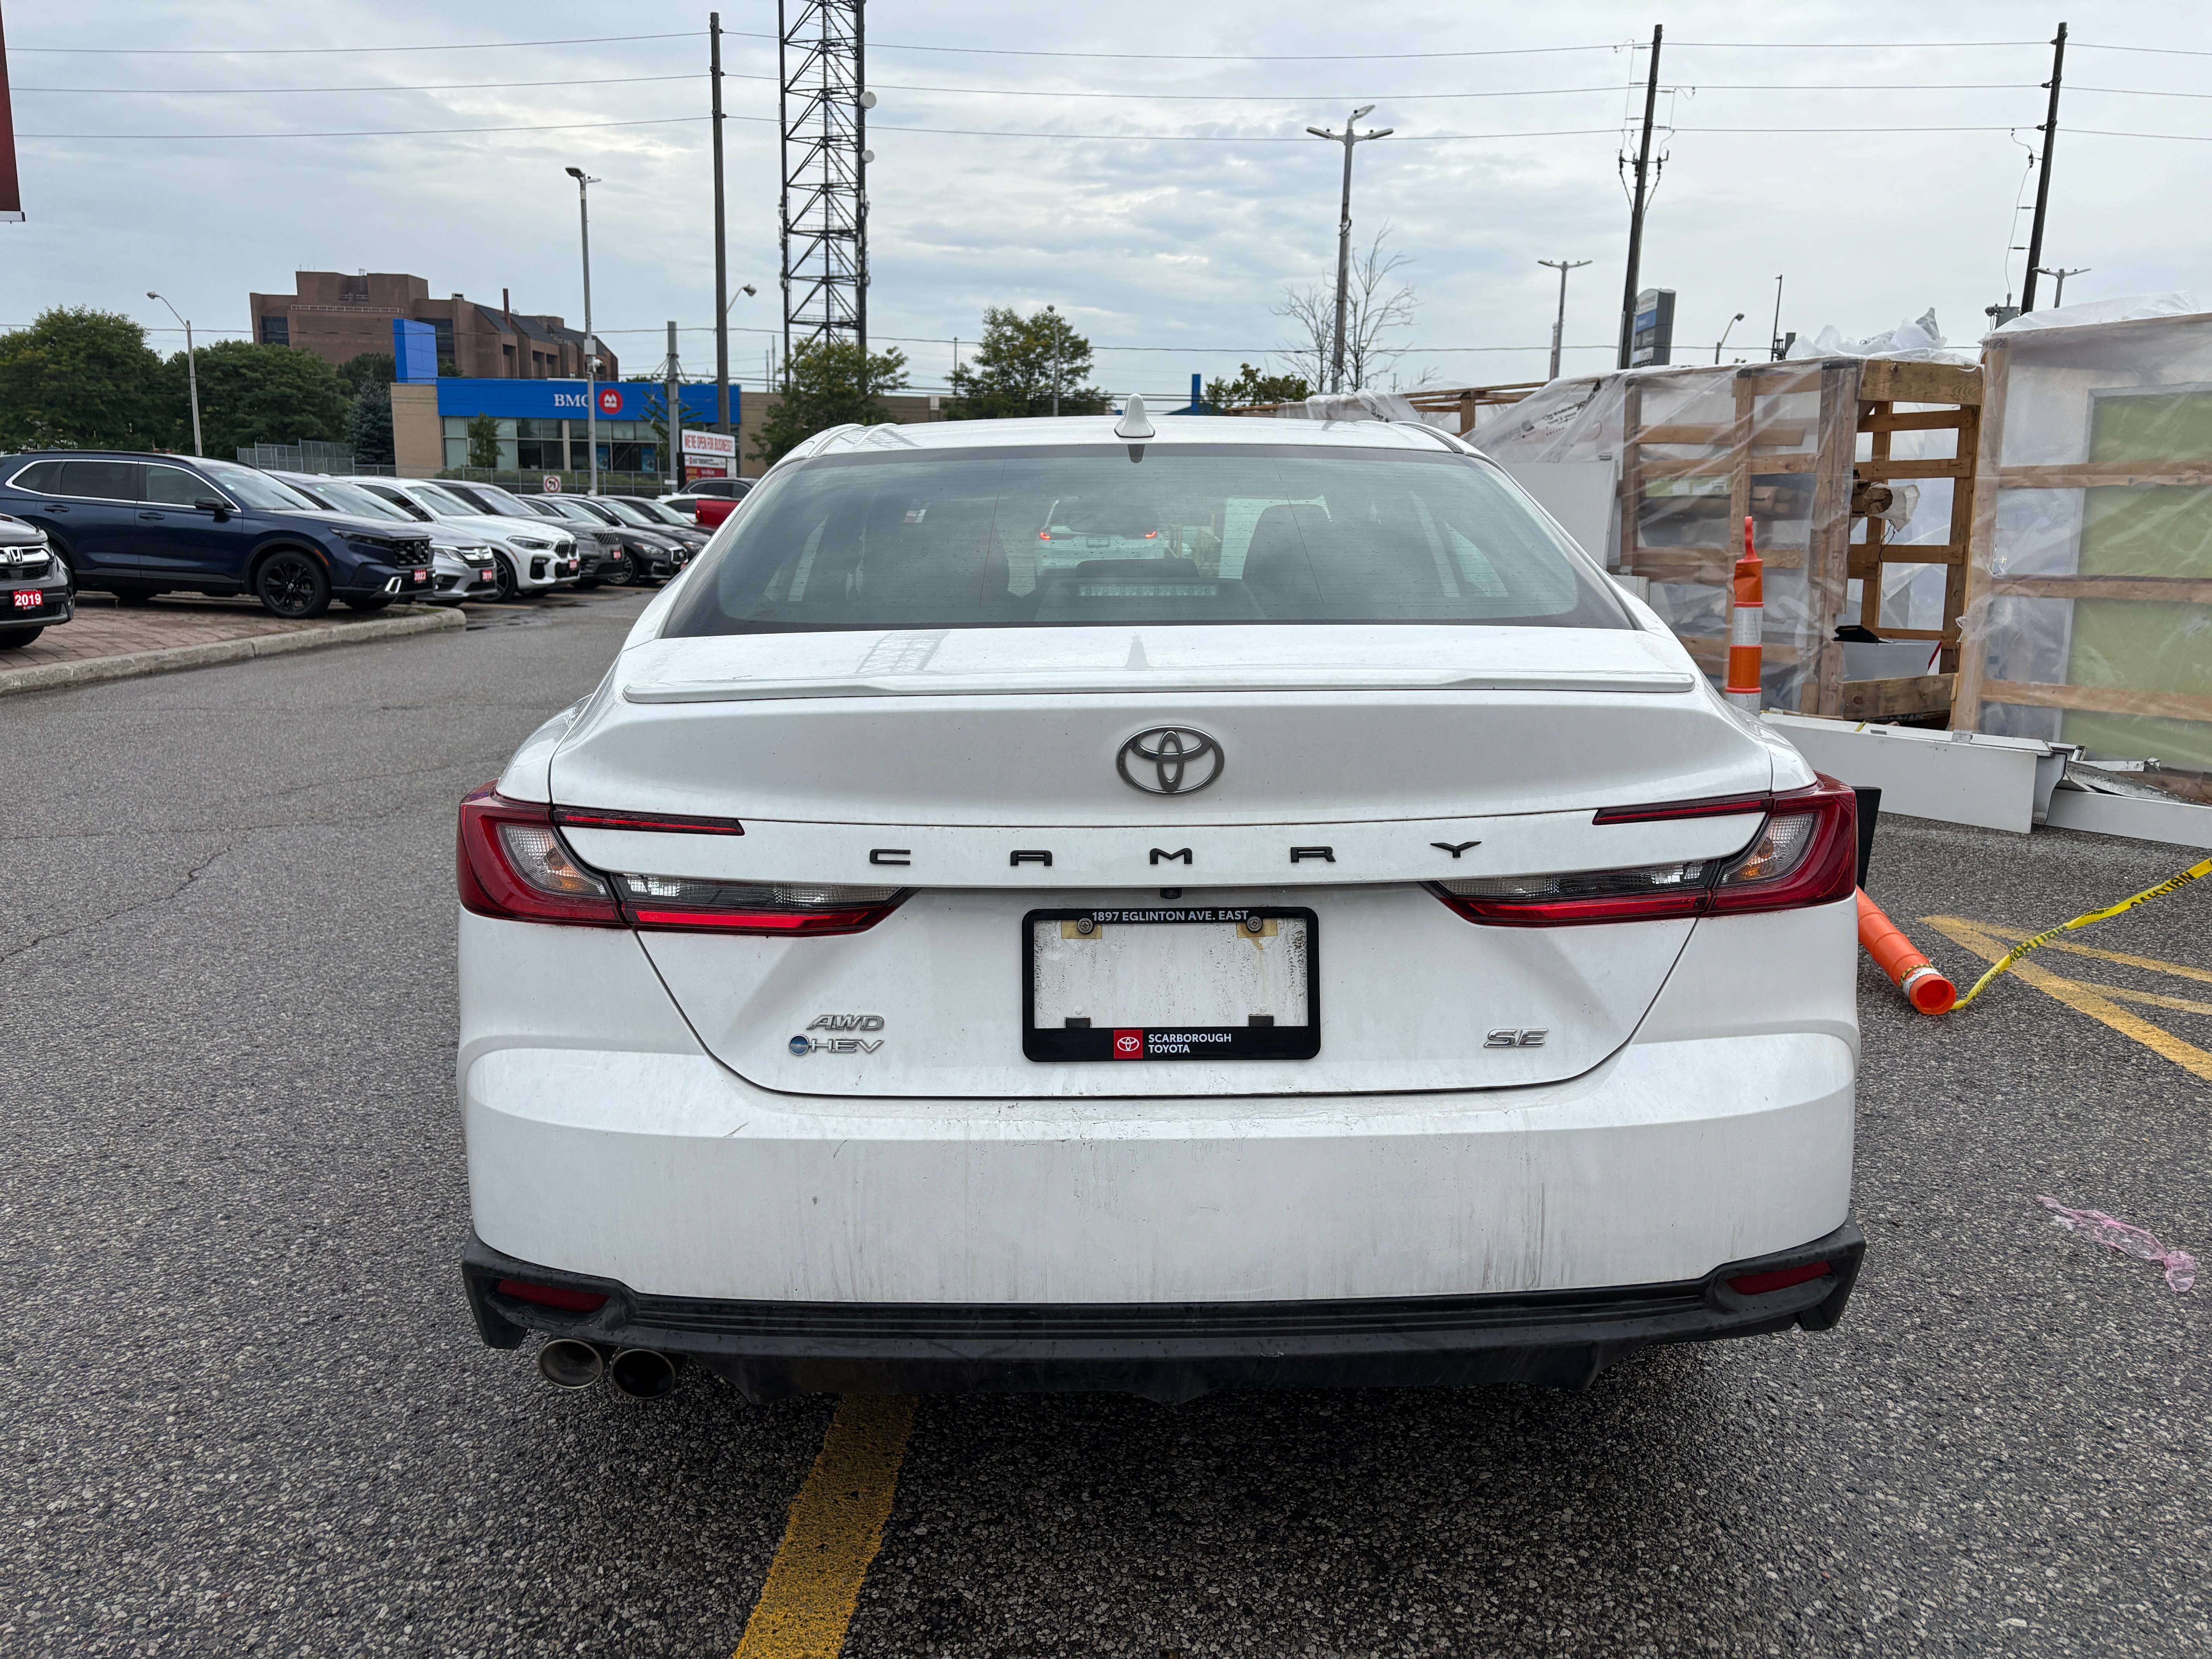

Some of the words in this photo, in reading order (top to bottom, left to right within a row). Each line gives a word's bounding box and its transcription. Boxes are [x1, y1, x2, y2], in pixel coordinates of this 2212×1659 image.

[697, 436, 706, 450] OPEN
[15, 593, 41, 606] 2019
[869, 841, 1482, 867] CAMRY
[1092, 911, 1119, 921] 1897
[1122, 911, 1187, 921] EGLINTON
[1188, 910, 1216, 921] AVE.
[1218, 910, 1249, 920] EAST
[806, 1014, 885, 1030] AWD
[1148, 1034, 1231, 1043] SCARBOROUGH
[1484, 1028, 1549, 1048] SE
[811, 1039, 885, 1054] HEV
[1148, 1044, 1190, 1053] TOYOTA
